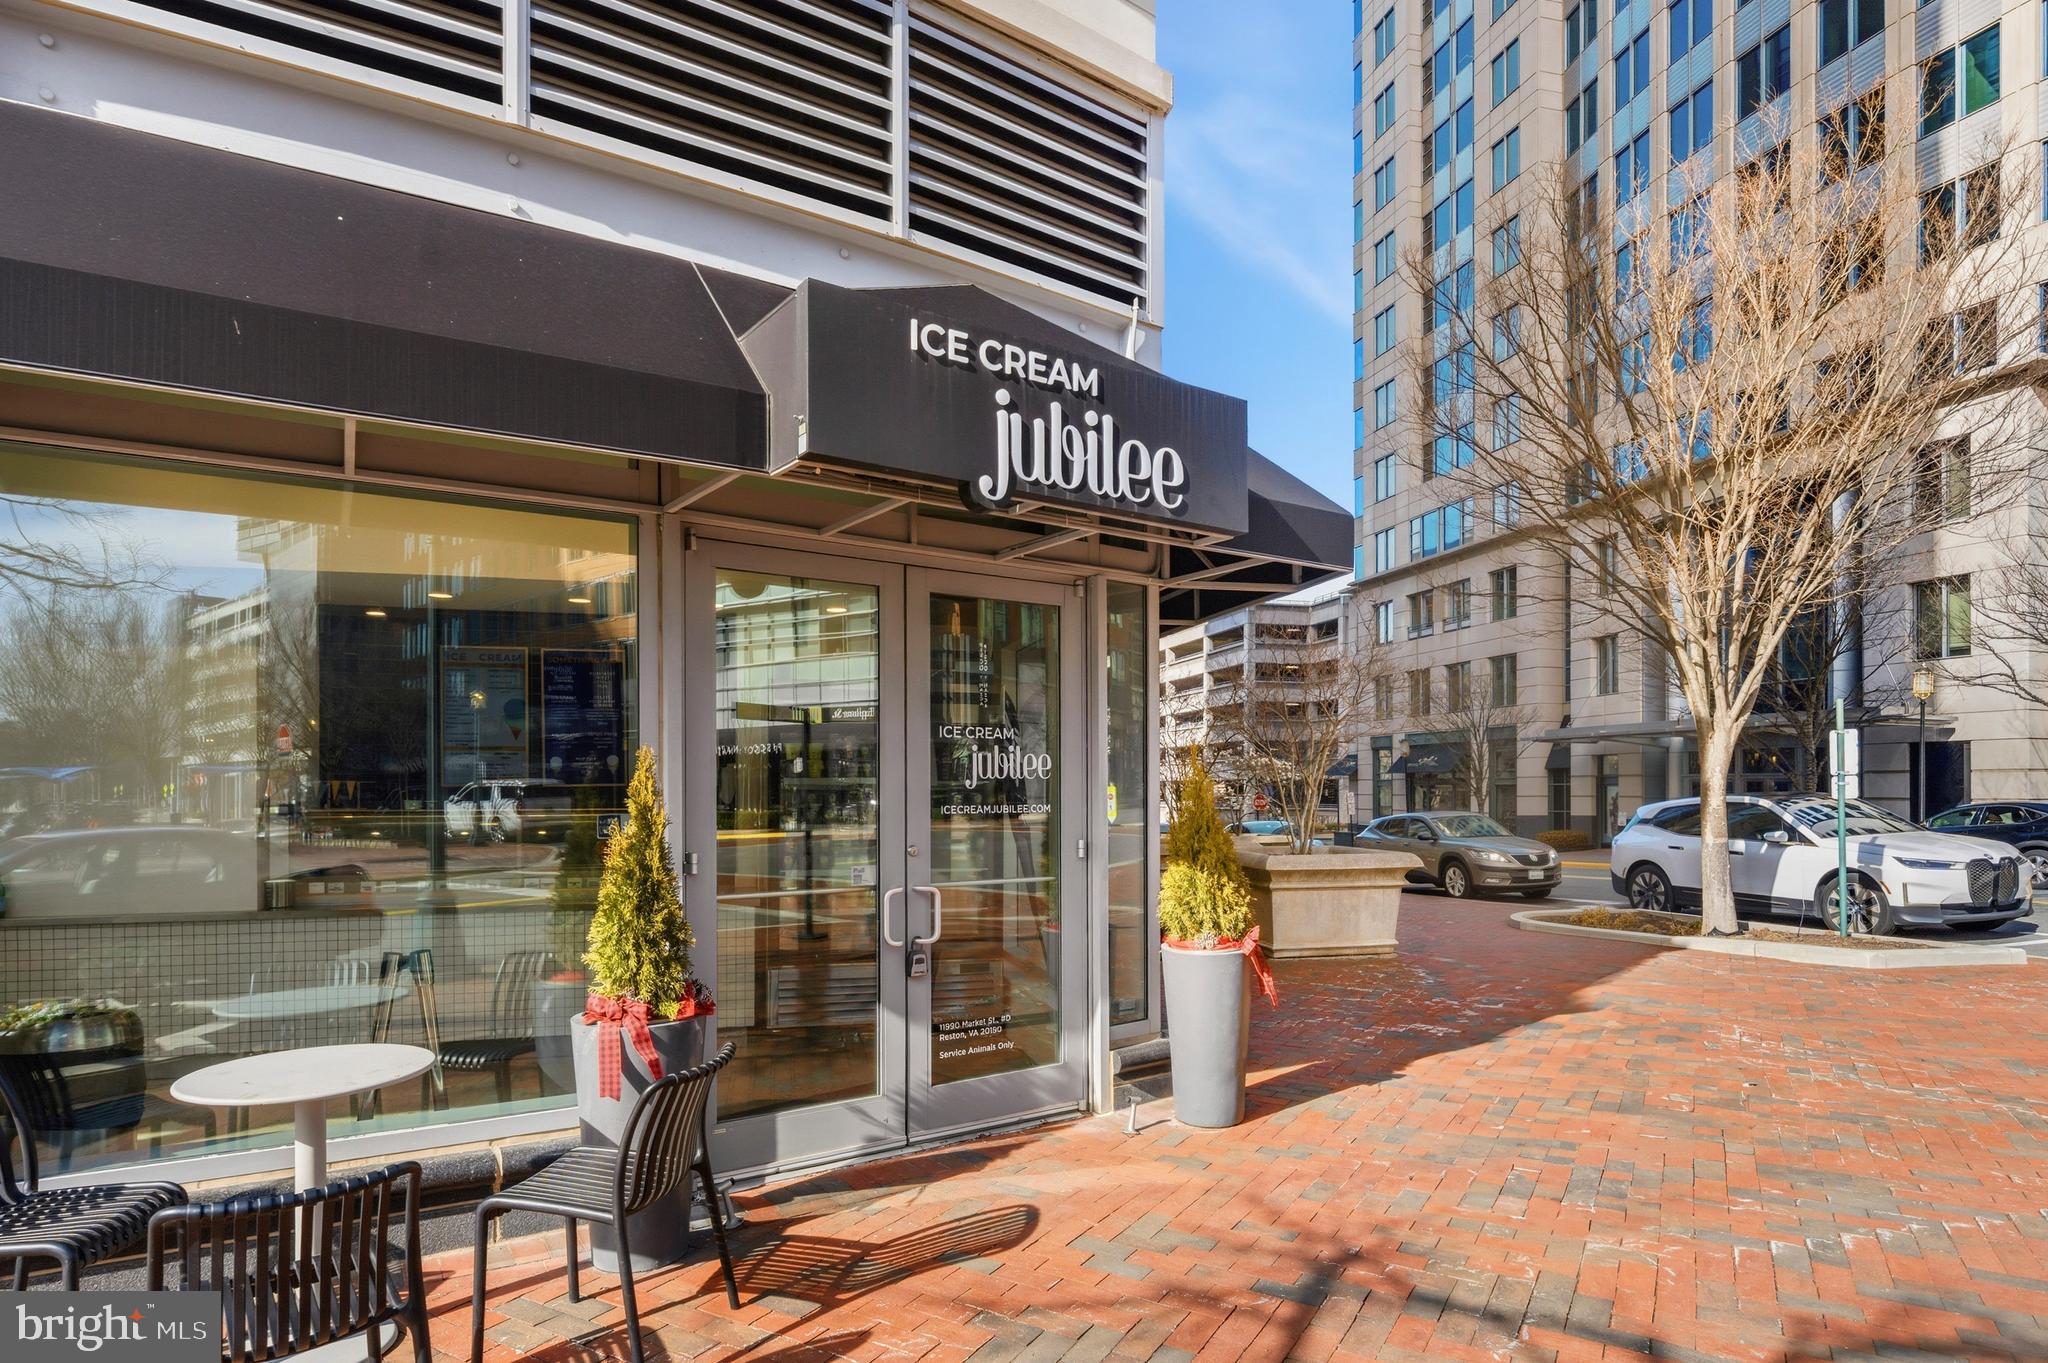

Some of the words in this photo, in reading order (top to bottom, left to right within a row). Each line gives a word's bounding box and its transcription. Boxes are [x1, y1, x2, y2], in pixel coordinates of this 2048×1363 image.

[910, 318, 970, 364] ICE
[978, 339, 1099, 397] CREAM
[978, 388, 1185, 510] jubilee
[939, 725, 962, 739] ICE
[965, 727, 1014, 740] CREAM
[965, 744, 1052, 789] jubilee
[940, 804, 1051, 815] ICECREAMJUBILEE.COM
[939, 1021, 960, 1031] 11990
[962, 1018, 986, 1029] Market
[940, 1031, 967, 1042] Reston,
[968, 1028, 979, 1037] VA
[940, 1048, 966, 1059] Service
[967, 1044, 997, 1055] Animals
[997, 1040, 1015, 1050] Only
